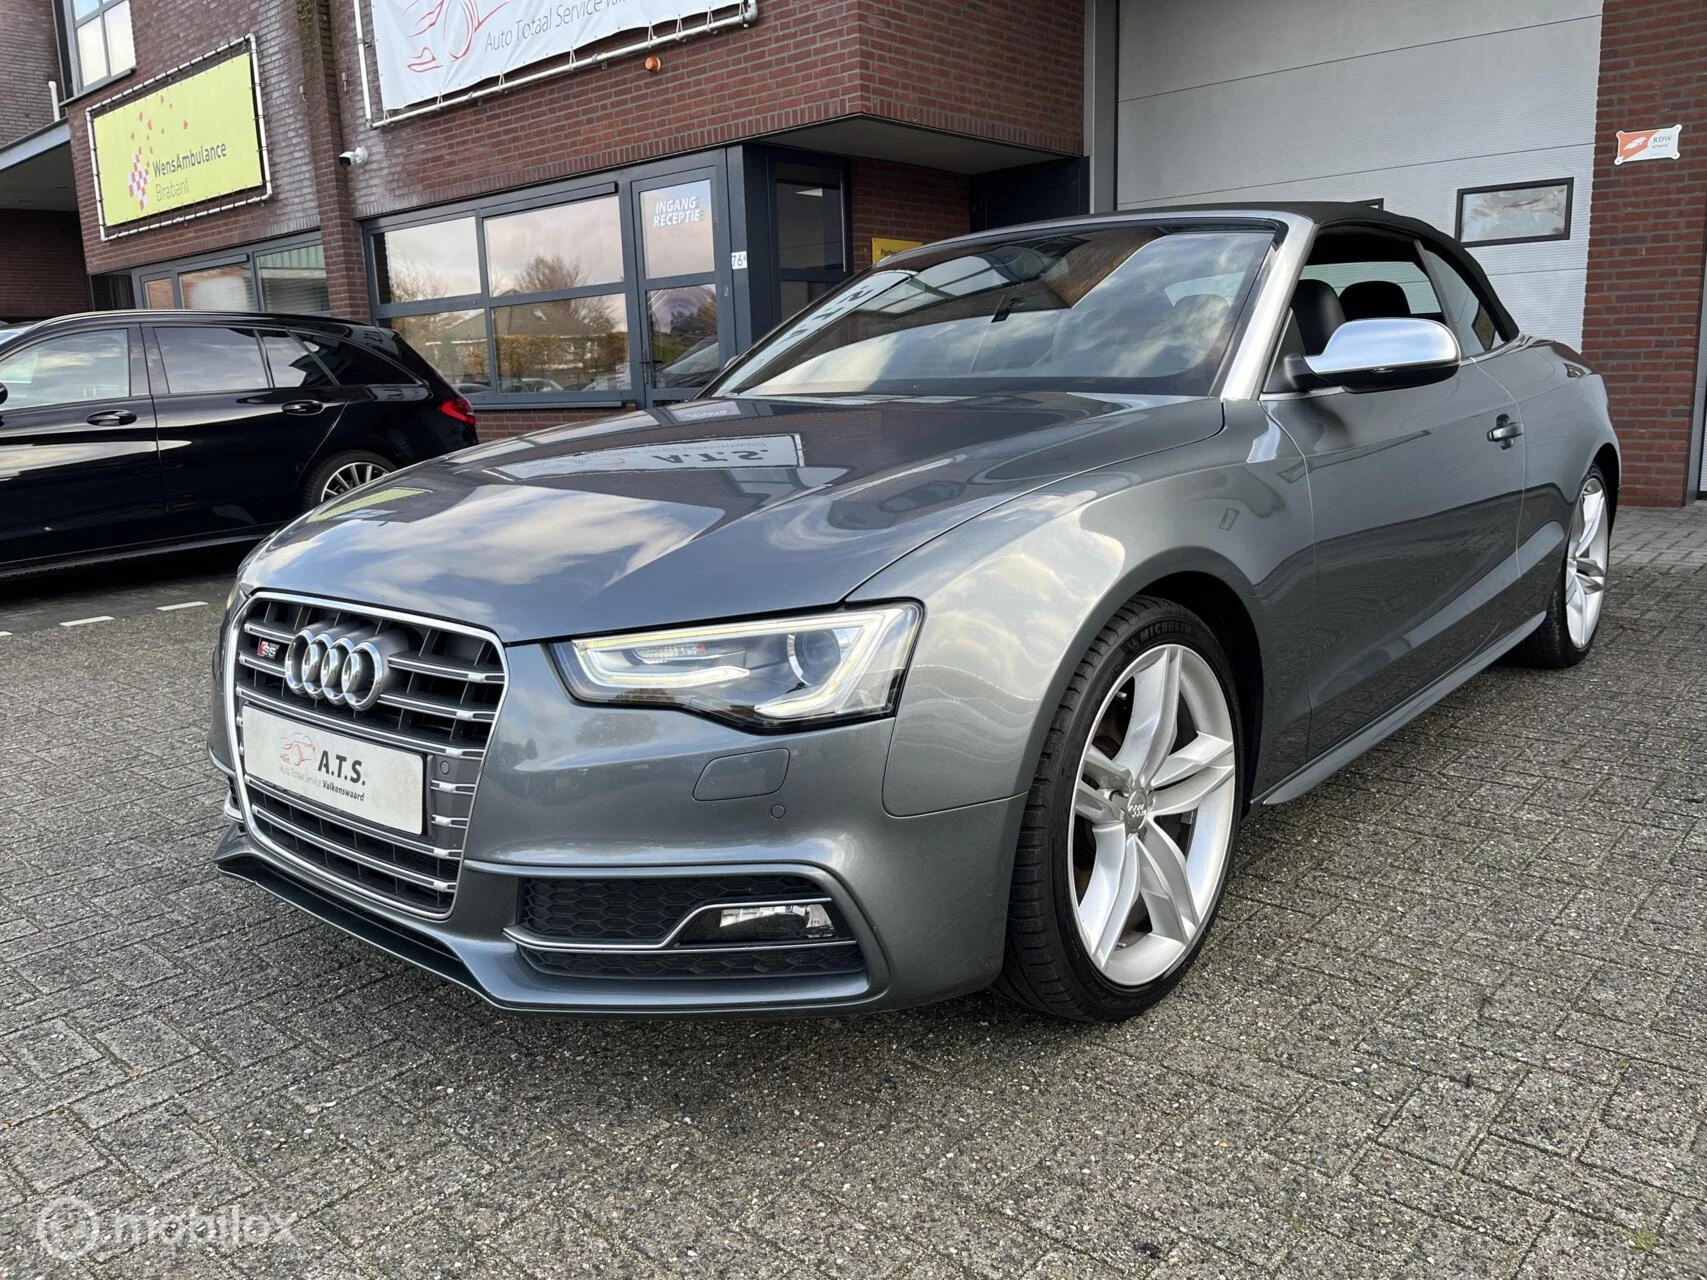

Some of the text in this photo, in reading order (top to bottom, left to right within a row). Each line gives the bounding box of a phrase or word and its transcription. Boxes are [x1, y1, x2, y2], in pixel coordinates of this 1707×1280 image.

[484, 0, 602, 53] Auto Totaal Service
[152, 142, 227, 178] WensAmbulance
[155, 177, 190, 202] Brabant
[655, 196, 697, 214] INGANG
[653, 209, 702, 228] RECEPTIE
[1140, 621, 1192, 642] MICHELIN
[317, 750, 366, 786] A.T.S.
[322, 780, 365, 801] Valkenswaard
